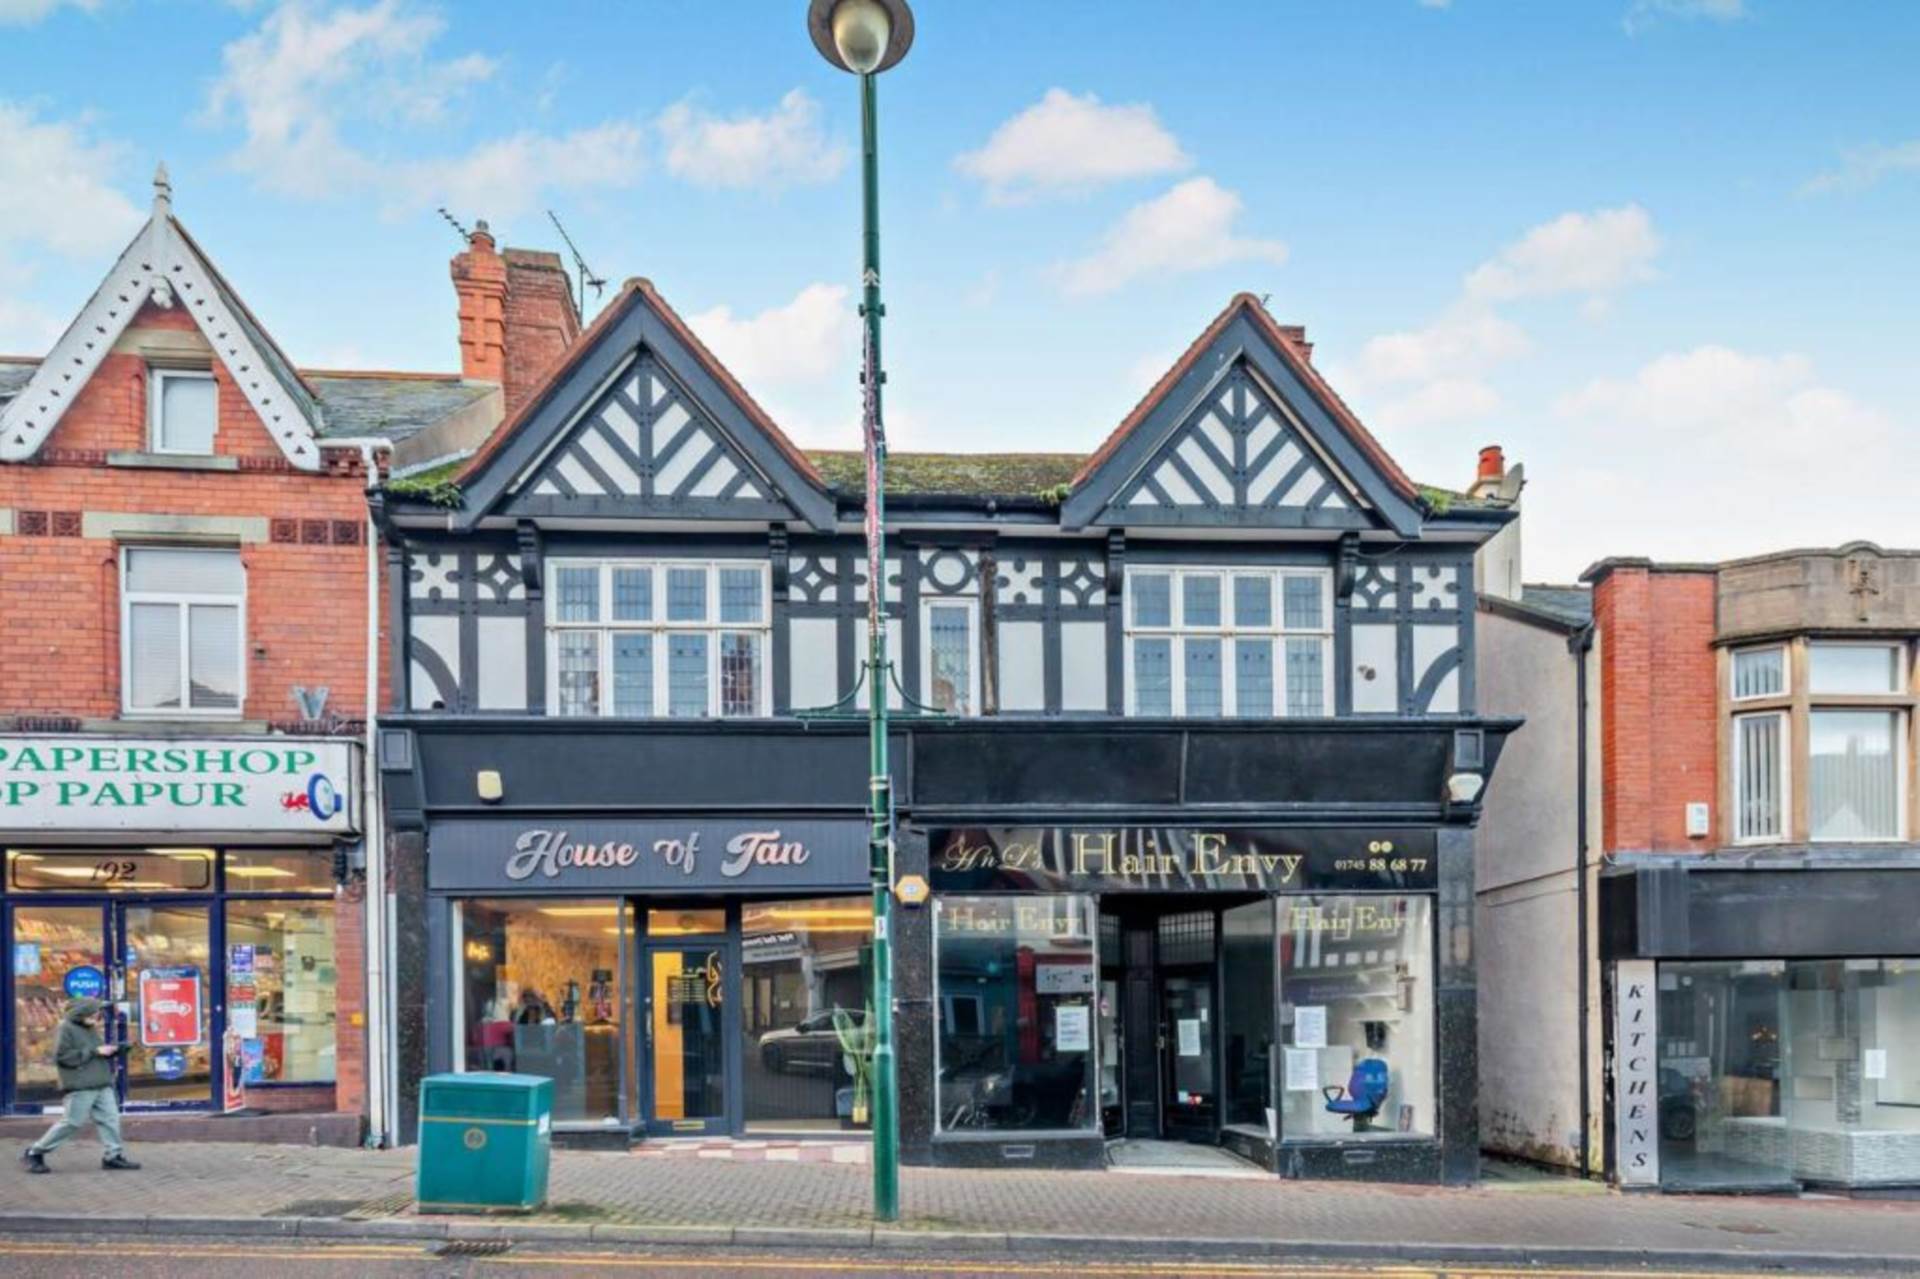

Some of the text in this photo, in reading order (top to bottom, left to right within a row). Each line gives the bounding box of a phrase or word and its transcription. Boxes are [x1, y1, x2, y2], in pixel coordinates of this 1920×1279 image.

[0, 747, 316, 774] APERSHOP
[56, 781, 247, 806] PAPUR
[505, 829, 810, 880] House of Tan
[1070, 833, 1303, 884] Hair Envy
[1334, 858, 1427, 872] 01745 88 68 77
[90, 861, 137, 882] 192
[1628, 983, 1649, 1169] KITCHENS
